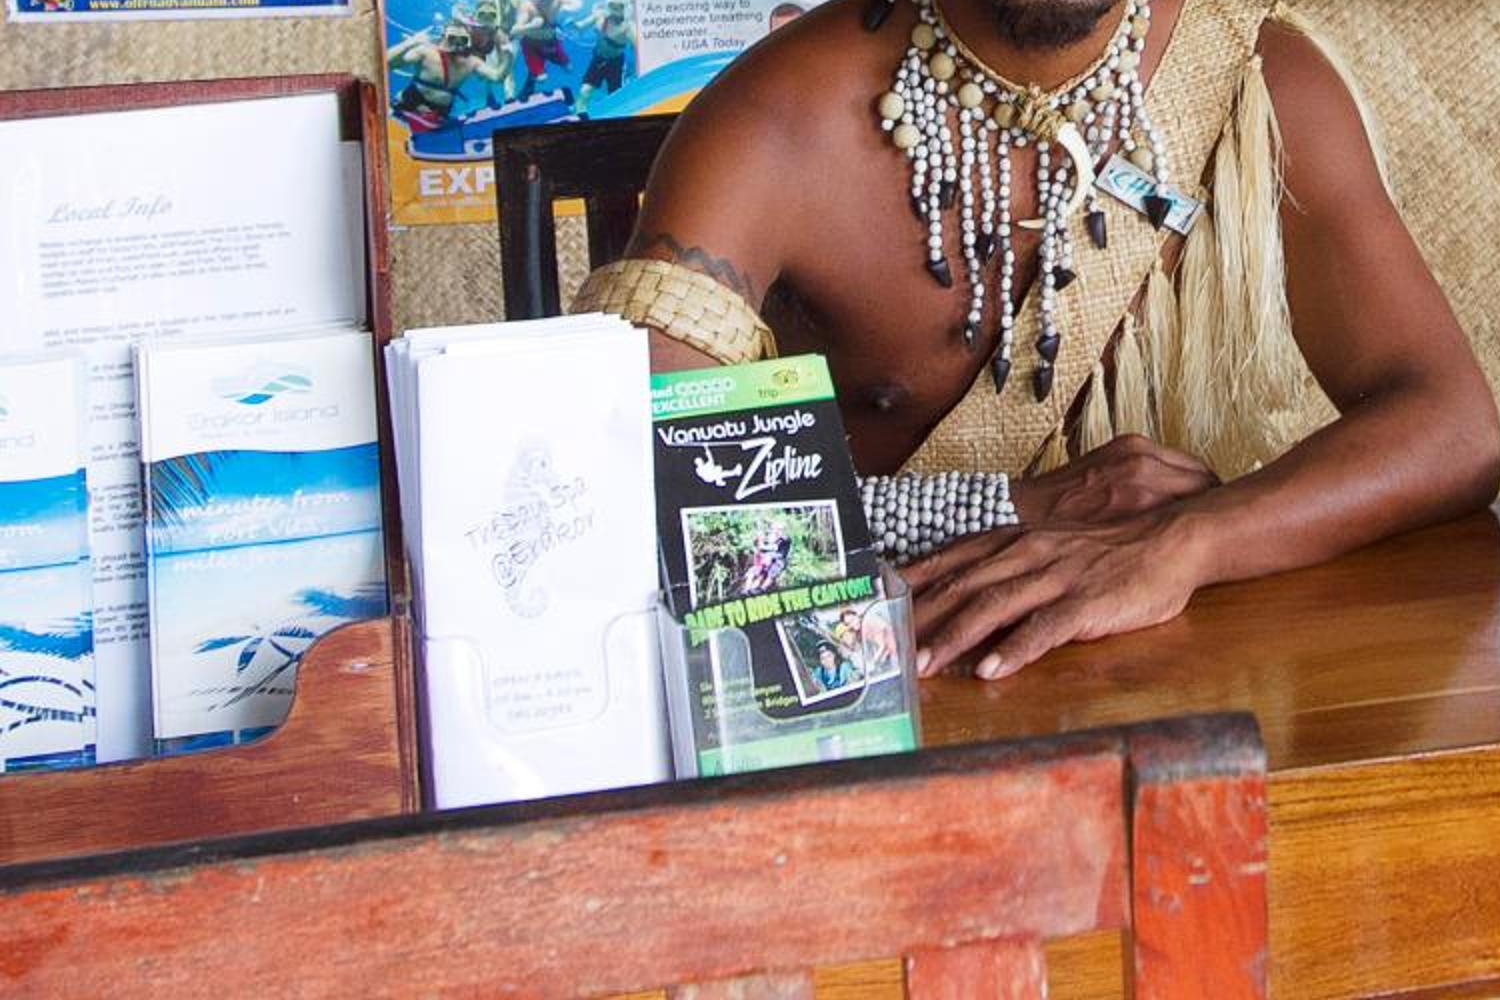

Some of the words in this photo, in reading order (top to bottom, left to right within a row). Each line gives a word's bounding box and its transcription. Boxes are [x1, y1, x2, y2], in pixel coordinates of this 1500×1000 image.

[641, 14, 707, 26] experience
[708, 10, 764, 24] breathing
[665, 0, 710, 13] exciting
[713, 0, 737, 11] way
[681, 37, 709, 51] USA
[712, 36, 746, 50] Today
[47, 197, 113, 225] Local
[118, 193, 174, 222] Info
[657, 420, 747, 446] Vanuatu
[750, 409, 816, 434] Jungle
[735, 436, 823, 501] Zipline
